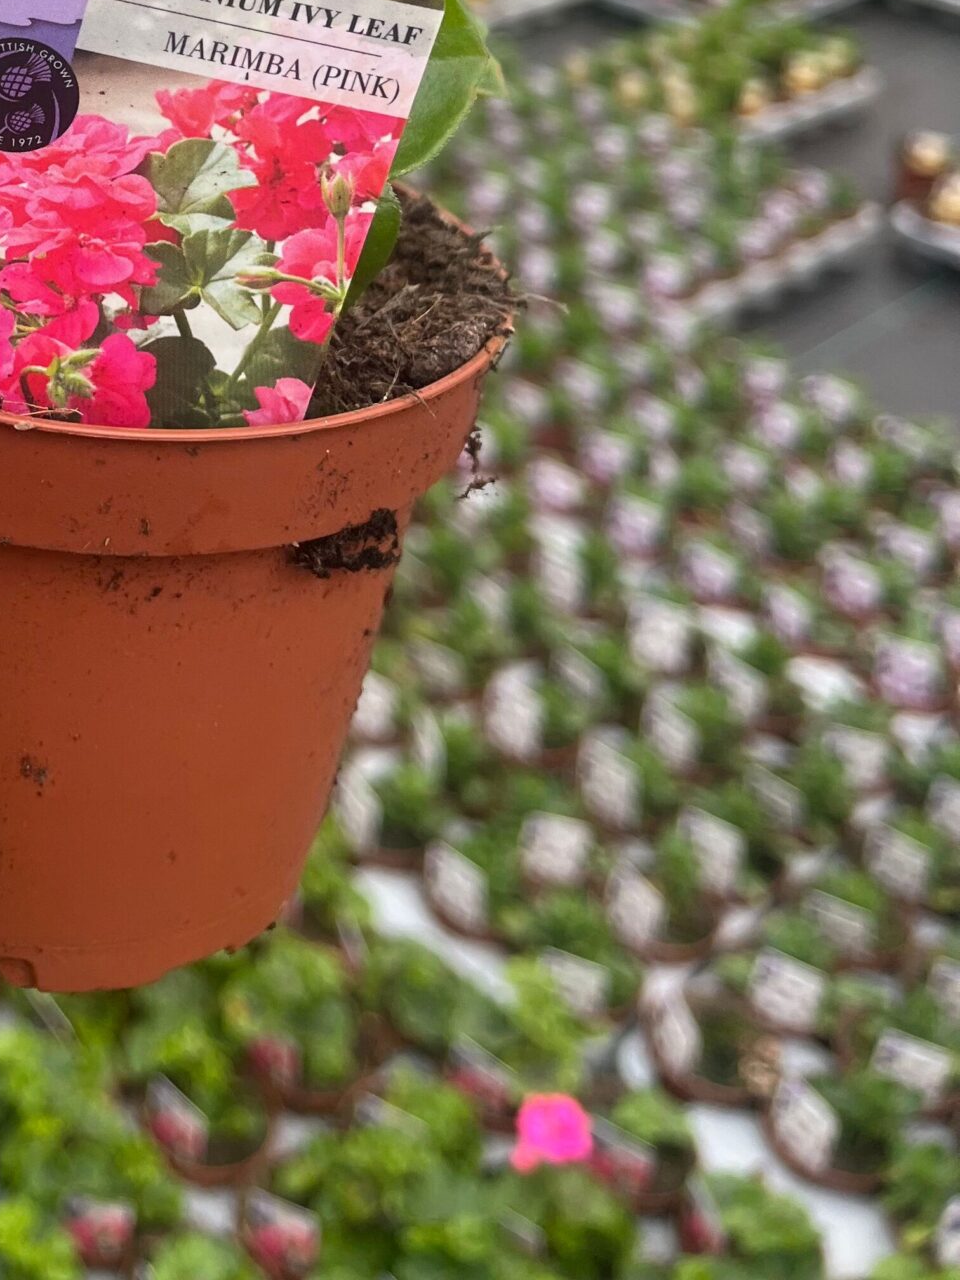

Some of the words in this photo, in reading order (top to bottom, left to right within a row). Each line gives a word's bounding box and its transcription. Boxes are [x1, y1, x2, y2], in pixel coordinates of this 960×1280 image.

[288, 1, 342, 29] IVY
[346, 14, 425, 46] LEAF
[39, 49, 74, 89] GROWN
[163, 31, 302, 81] MARIMBA
[312, 64, 400, 105] (PINK)
[11, 135, 43, 147] 1972
